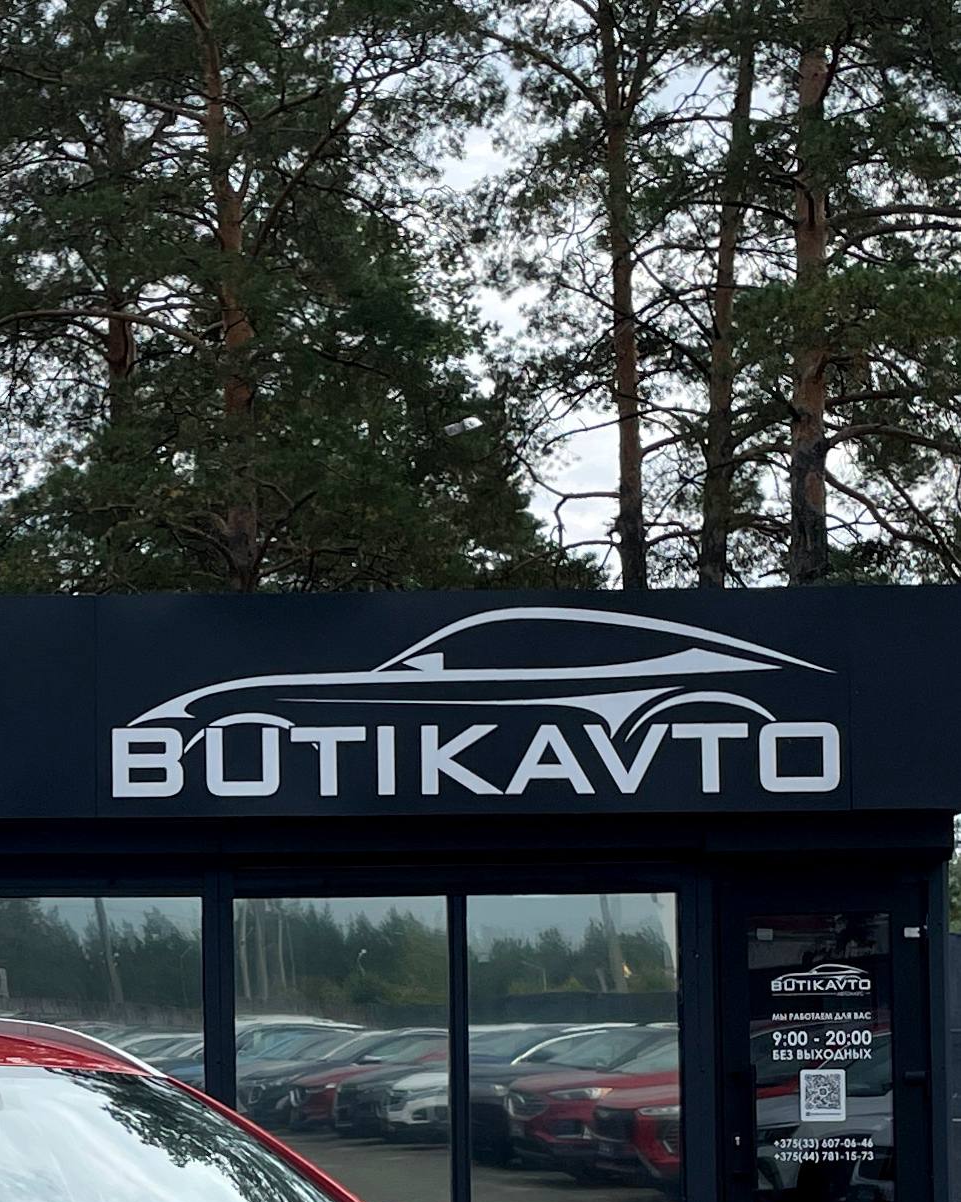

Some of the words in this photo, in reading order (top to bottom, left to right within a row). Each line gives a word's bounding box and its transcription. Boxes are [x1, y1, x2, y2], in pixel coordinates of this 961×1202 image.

[111, 721, 840, 798] BUTIKAVTO
[771, 979, 871, 992] BUTIKAVTO
[772, 1012, 787, 1021] МЫ
[788, 1012, 833, 1021] РАБОТАЕМ
[834, 1012, 852, 1020] ДЛЯ
[853, 1011, 872, 1020] ВАС
[772, 1030, 808, 1047] 9:00
[825, 1029, 872, 1046] 20:00
[772, 1049, 794, 1061] БЕЗ
[796, 1048, 872, 1060] ВЫХОДНЫХ
[773, 1138, 819, 1150] +375(33)
[773, 1151, 819, 1163] +375(44)
